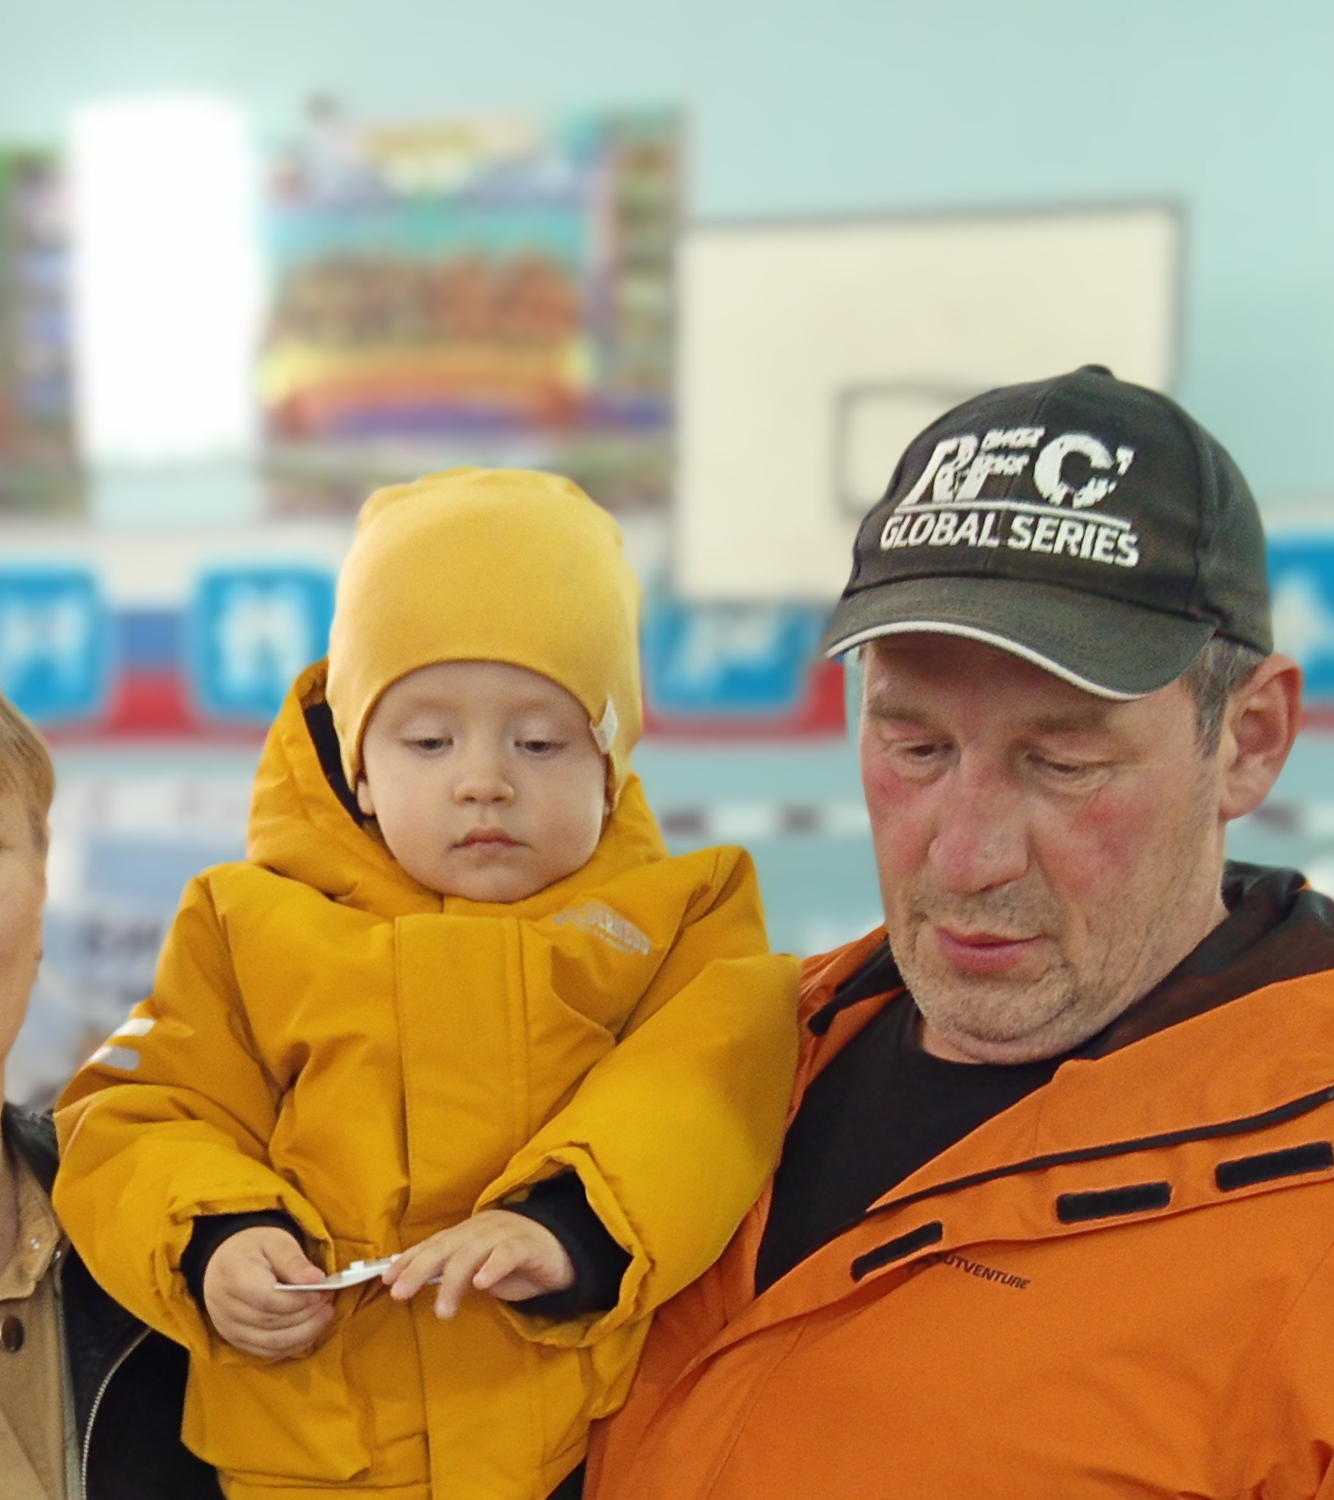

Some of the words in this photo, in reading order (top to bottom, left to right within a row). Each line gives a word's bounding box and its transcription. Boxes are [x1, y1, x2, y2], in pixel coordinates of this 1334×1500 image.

[880, 512, 1000, 549] GLOBAL
[1007, 514, 1140, 568] SERIES
[937, 1252, 1031, 1289] UTVENTURE
